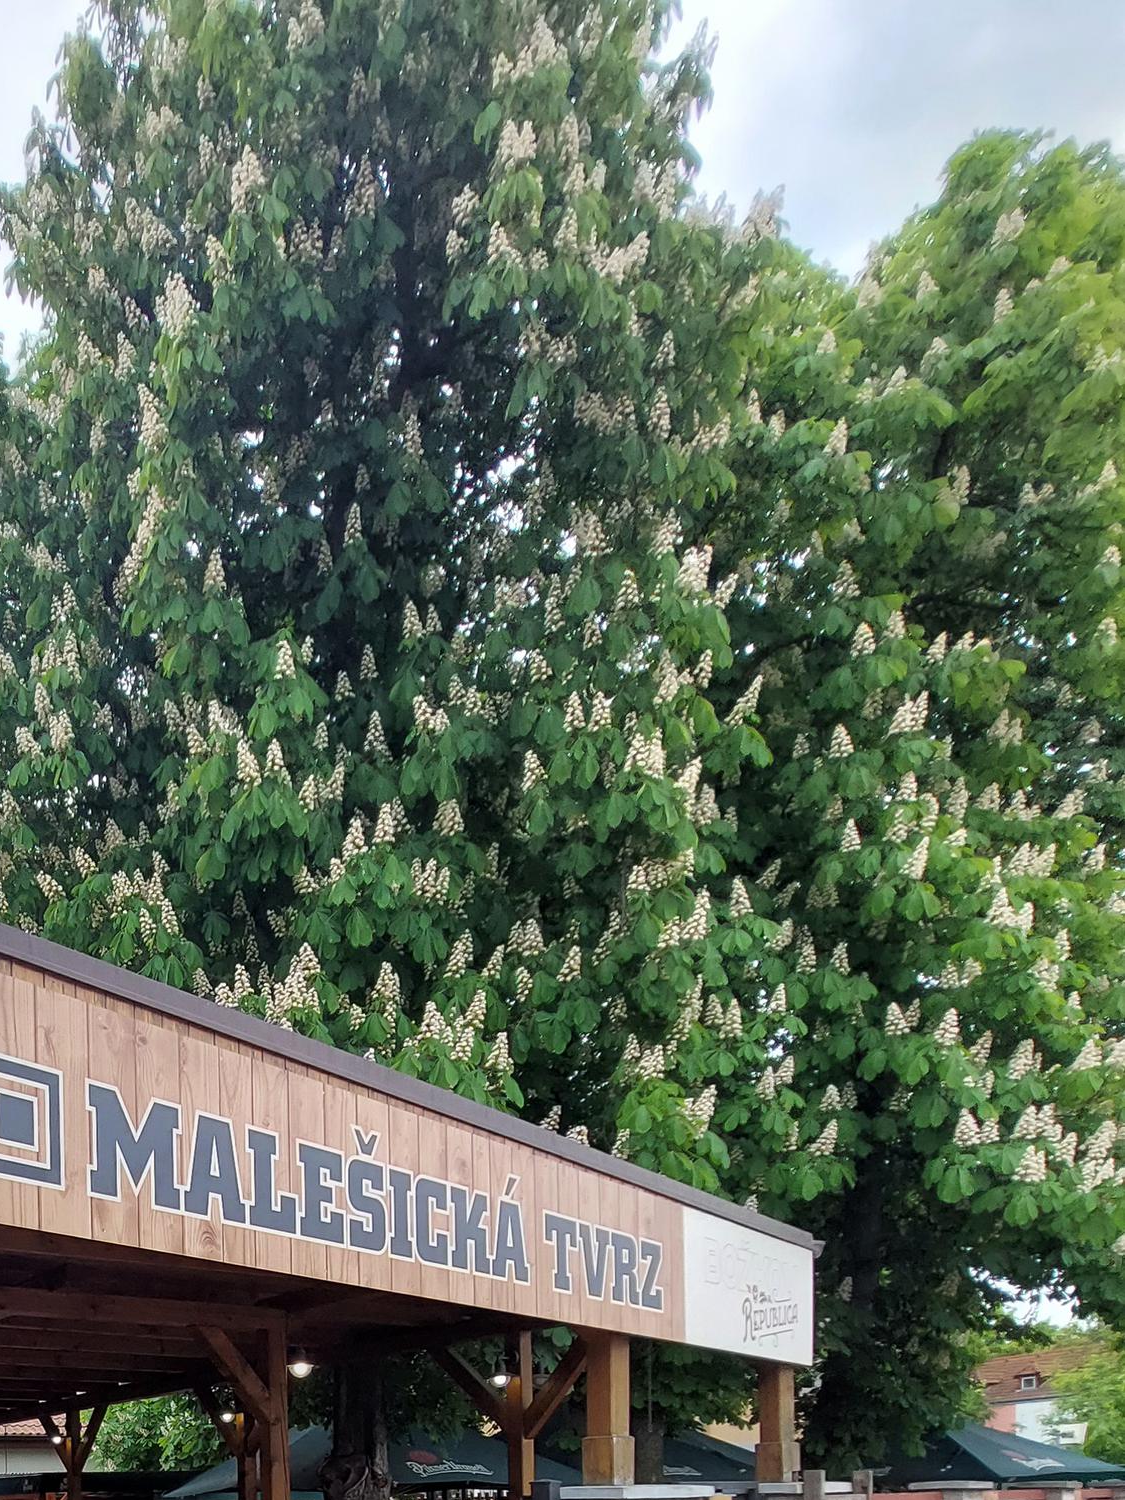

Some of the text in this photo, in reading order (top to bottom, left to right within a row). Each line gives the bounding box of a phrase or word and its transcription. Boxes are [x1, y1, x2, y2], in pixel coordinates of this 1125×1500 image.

[86, 1078, 665, 1312] MALEŠICKÁ TVRZ
[741, 1296, 799, 1343] REPUBLICA
